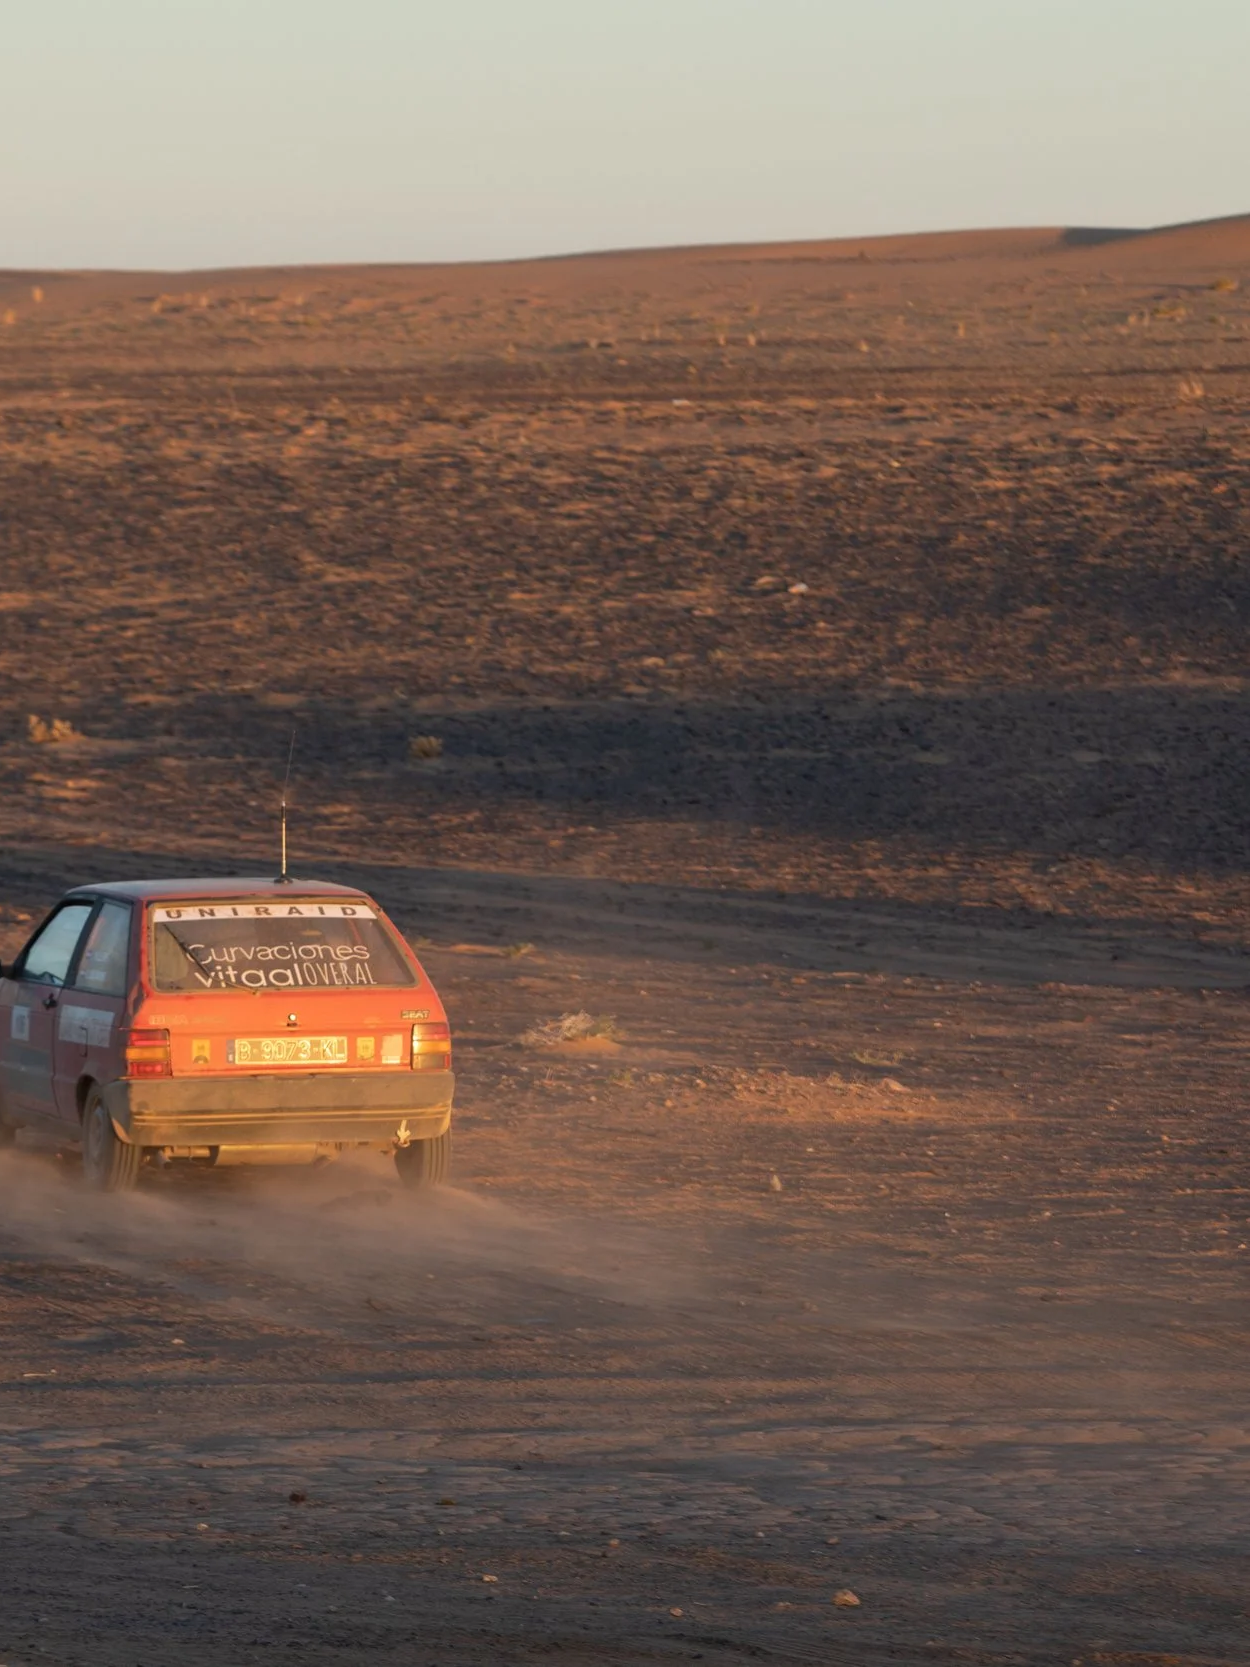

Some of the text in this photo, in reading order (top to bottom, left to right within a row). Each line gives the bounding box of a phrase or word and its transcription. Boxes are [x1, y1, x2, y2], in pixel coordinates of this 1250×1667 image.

[165, 905, 358, 919] UNIRAID
[186, 942, 370, 965] Curvaciones
[401, 1010, 430, 1019] SEAT
